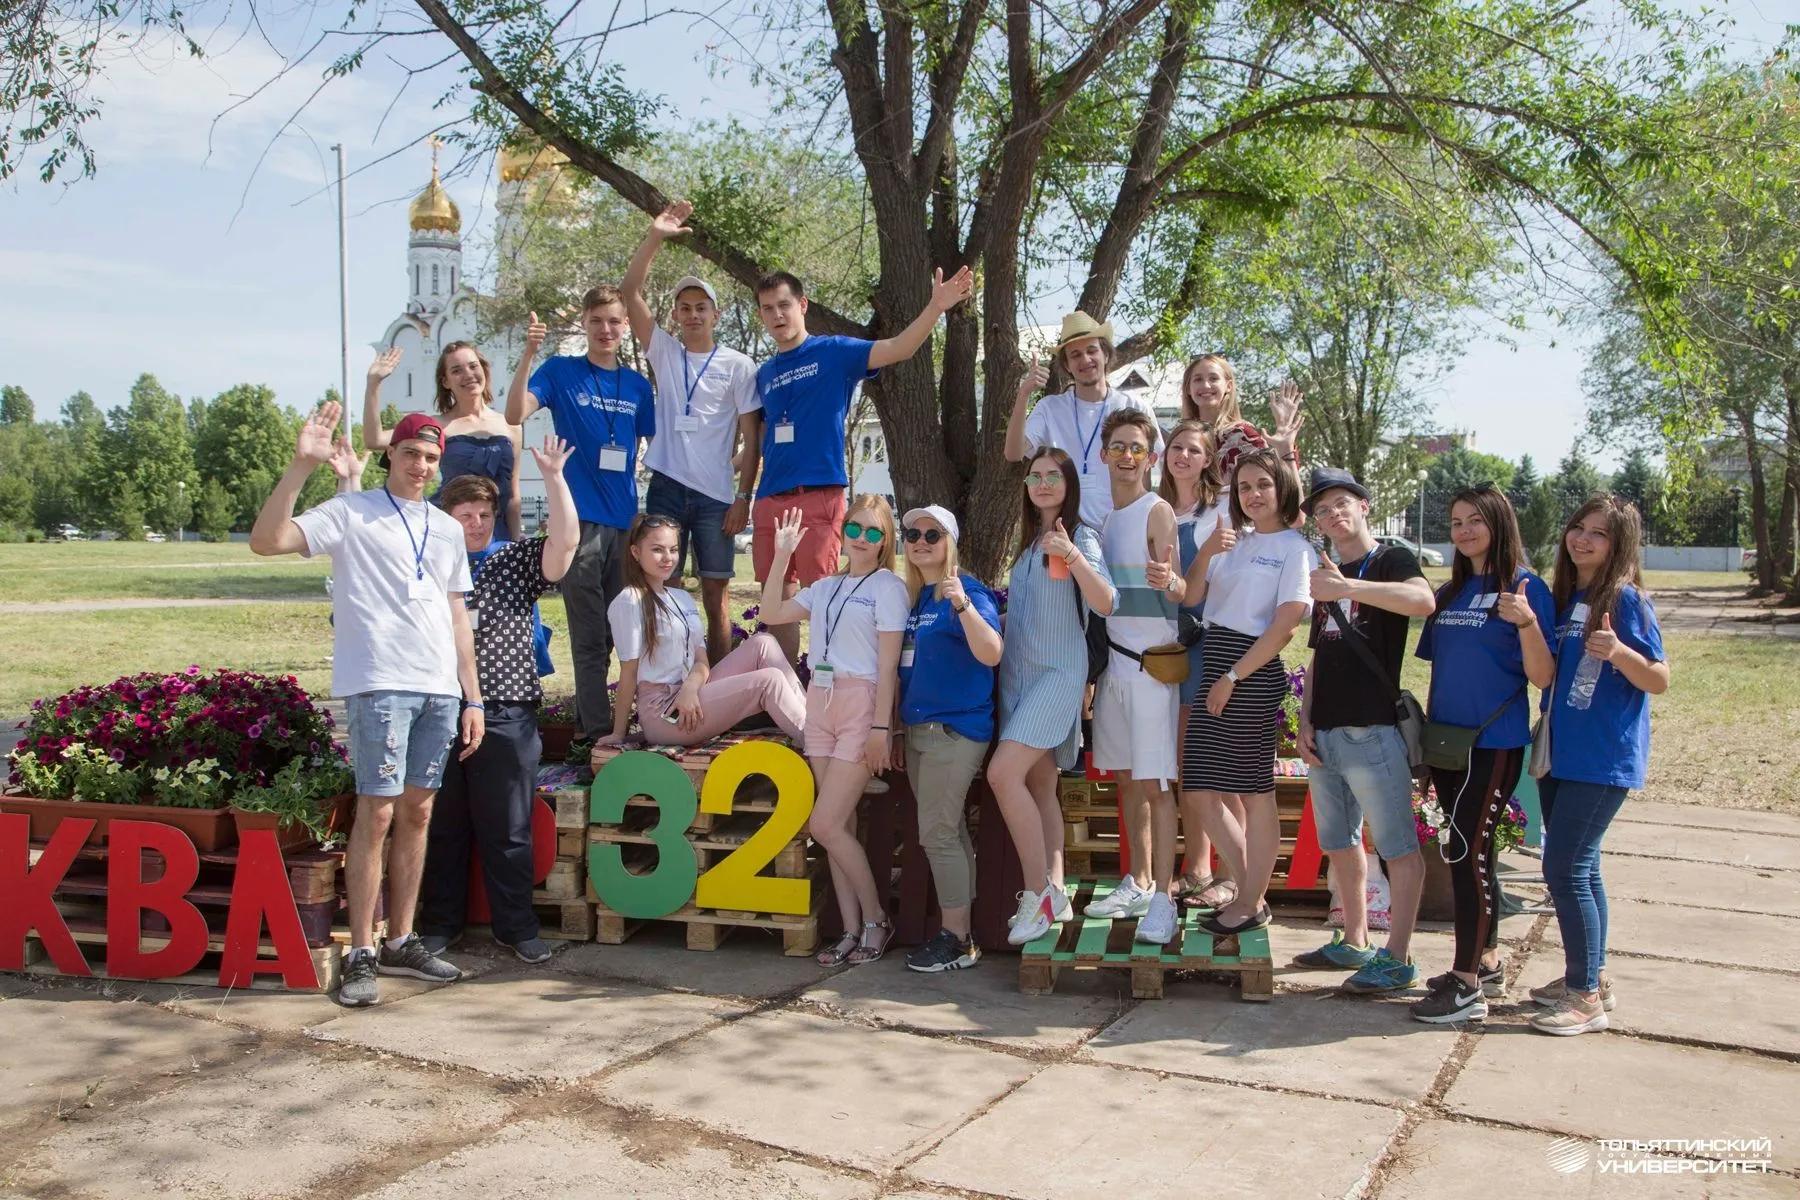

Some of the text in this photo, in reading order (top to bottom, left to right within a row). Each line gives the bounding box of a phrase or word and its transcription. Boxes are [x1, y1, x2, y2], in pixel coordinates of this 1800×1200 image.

[589, 741, 815, 919] 32
[1478, 788, 1503, 915] NEVER STOP
